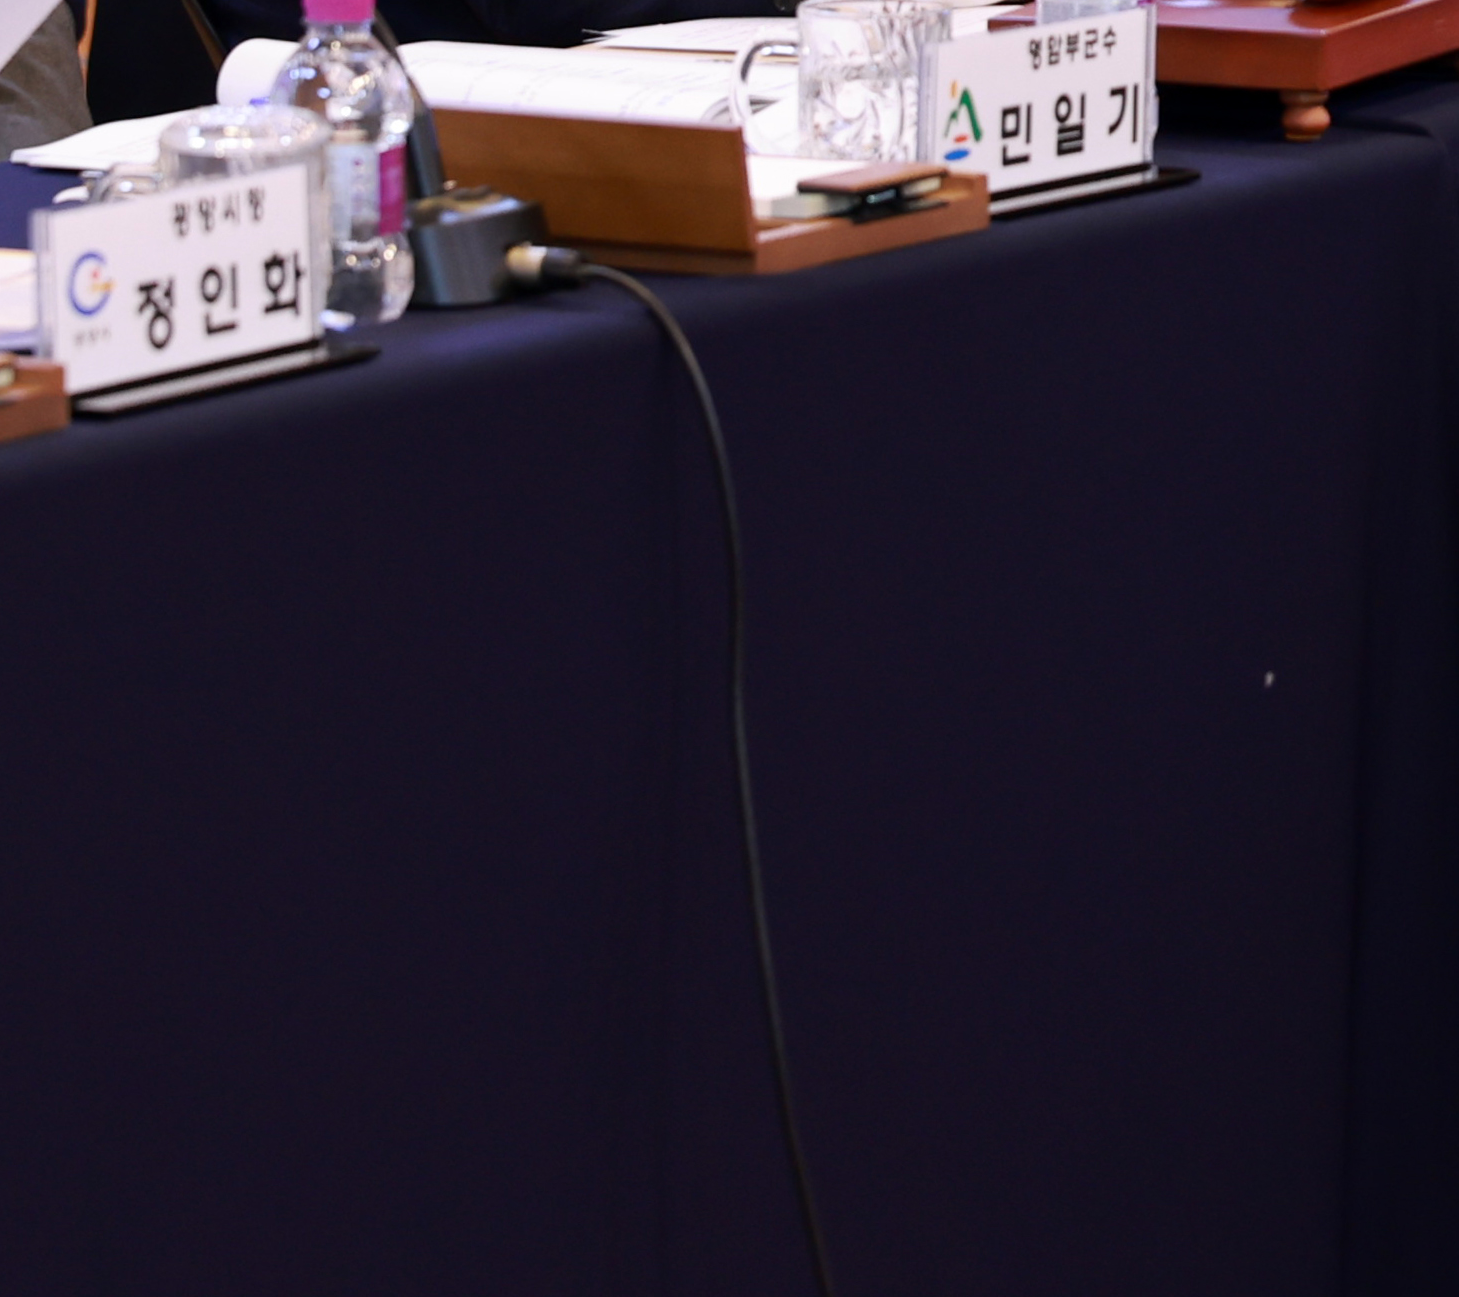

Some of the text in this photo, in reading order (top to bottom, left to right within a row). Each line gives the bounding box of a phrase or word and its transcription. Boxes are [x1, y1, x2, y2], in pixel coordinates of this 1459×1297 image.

[1029, 26, 1117, 70] 영암부군수
[1001, 83, 1139, 166] 민일기
[138, 251, 303, 349] 정인화
